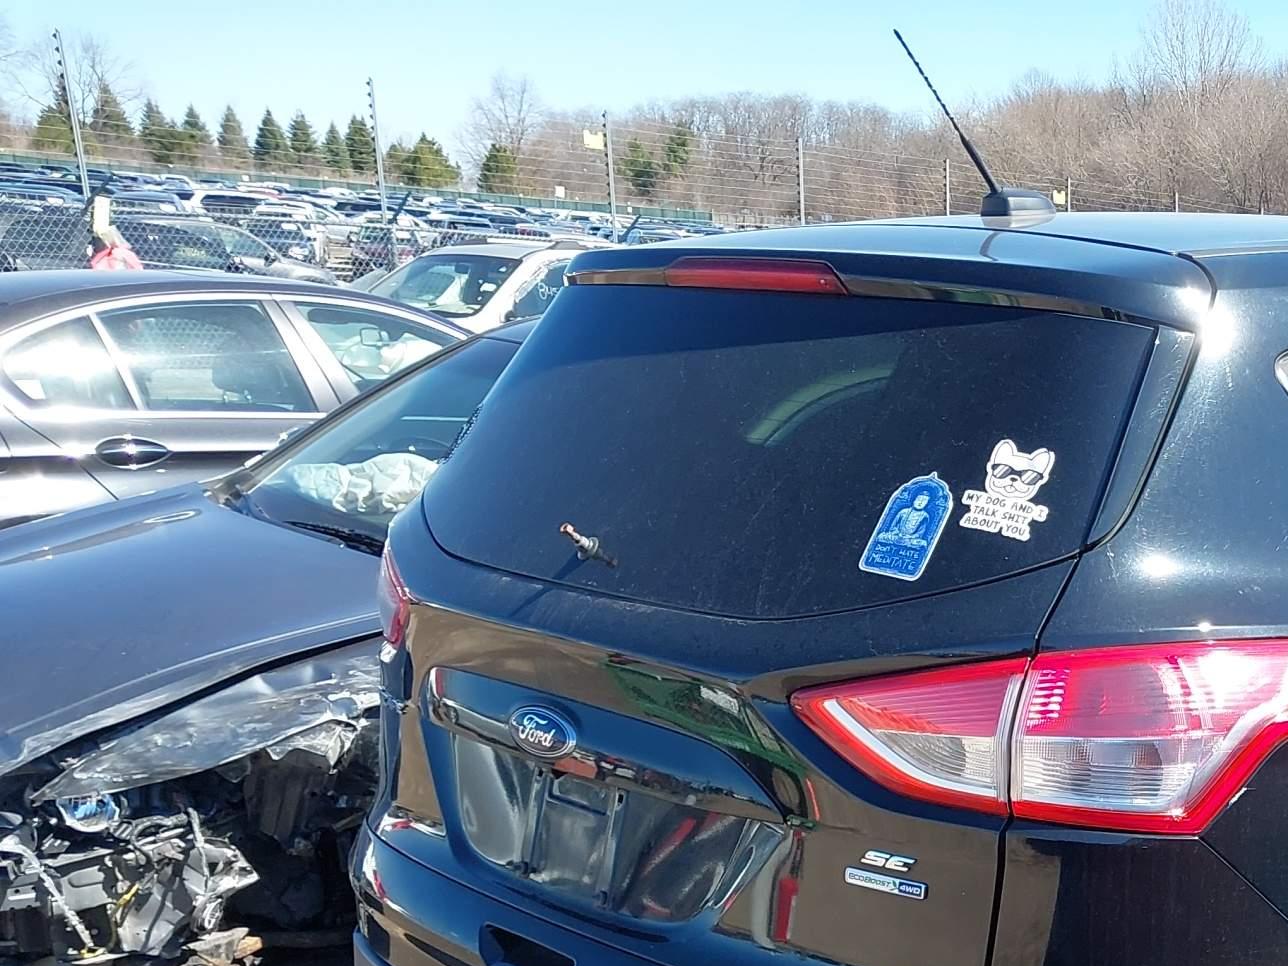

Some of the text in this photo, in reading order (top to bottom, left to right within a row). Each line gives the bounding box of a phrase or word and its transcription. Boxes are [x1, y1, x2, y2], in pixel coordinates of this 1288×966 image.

[966, 493, 1044, 518] MY DOG AND I
[973, 506, 1028, 525] TALK SHIT
[964, 516, 1025, 536] ABOUT YOU
[868, 553, 916, 571] MEDITATE
[519, 714, 556, 747] Ford
[860, 850, 916, 872] SE
[899, 885, 921, 895] 4WD
